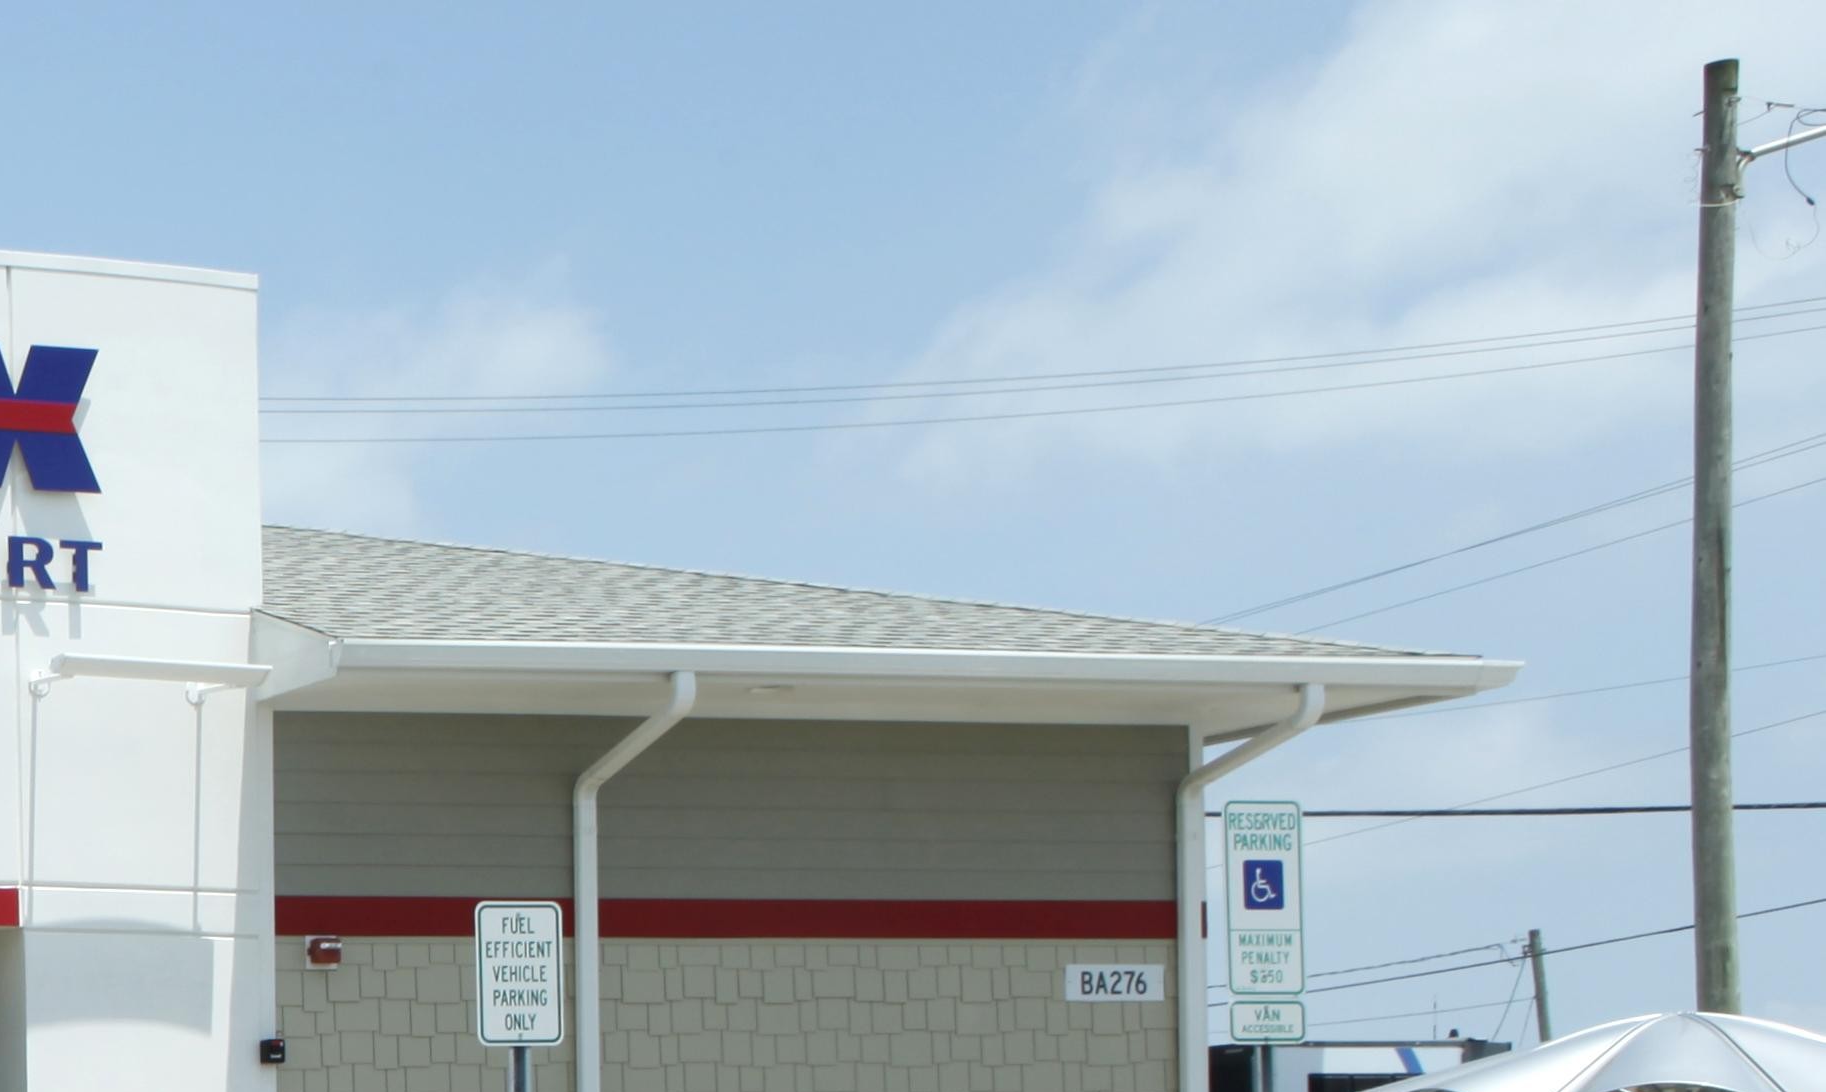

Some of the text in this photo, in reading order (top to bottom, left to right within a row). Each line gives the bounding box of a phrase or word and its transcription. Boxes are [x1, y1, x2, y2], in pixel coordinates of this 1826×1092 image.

[1228, 812, 1296, 830] RESERVED
[1233, 833, 1292, 851] PARKING
[502, 917, 535, 934] FUEL
[1238, 934, 1293, 946] MAXIMUM
[485, 941, 552, 958] EFFICIENT
[1241, 951, 1290, 965] PENALTY
[493, 965, 547, 982] VEHICLE
[1081, 971, 1147, 995] BA276
[493, 990, 547, 1006] PARKING
[505, 1014, 536, 1030] ONLY
[1254, 1009, 1280, 1021] VAN
[1241, 1024, 1294, 1033] ACCESSIBLE
